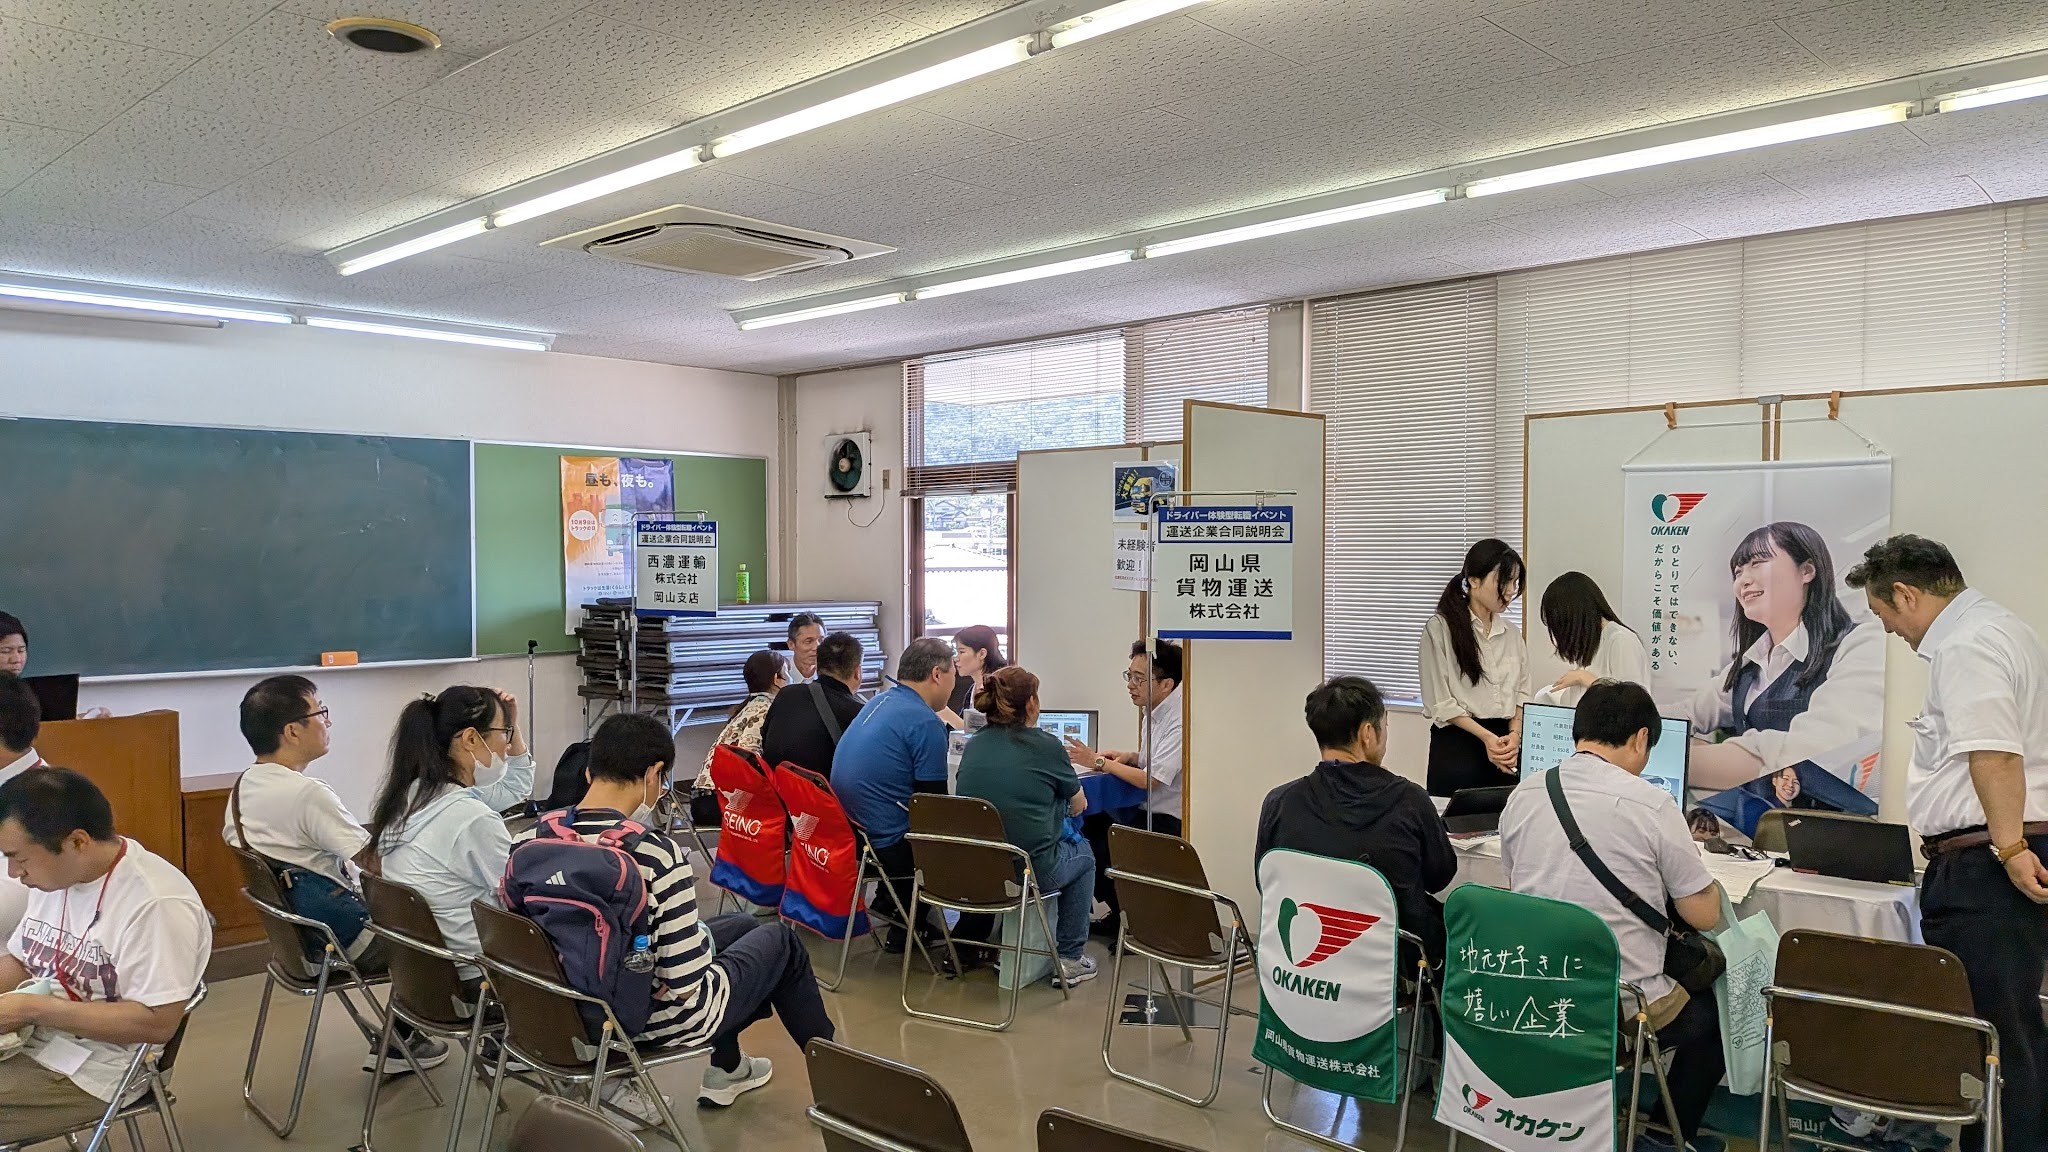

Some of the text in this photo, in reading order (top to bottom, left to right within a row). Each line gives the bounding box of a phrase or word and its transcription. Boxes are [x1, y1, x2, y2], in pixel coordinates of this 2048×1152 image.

[585, 473, 654, 488] 昼も、夜も。
[1166, 511, 1286, 520] ドライバー体験型転職イベント
[641, 534, 712, 544] 運送企業合同説明会
[1166, 525, 1285, 538] 運送企業合同説明会
[1651, 526, 1690, 536] OKAKEN
[648, 555, 706, 570] 西濃運輸
[1189, 553, 1260, 573] 岡山県
[655, 573, 698, 585] 株式会社
[1176, 578, 1273, 597] 貨物運送
[653, 591, 699, 604] 岡山支店
[1668, 543, 1681, 666] ひとりではできない、
[1189, 603, 1260, 619] 株式会社
[1651, 544, 1664, 670] だからこそ価値がある
[723, 811, 761, 836] SEINO
[1460, 937, 1583, 978] 地元好きに
[1272, 966, 1342, 1002] OKAKEN
[1464, 987, 1585, 1038] 嬉しい企業
[1265, 1028, 1380, 1078] 岡山県貨物運送株式会社
[1463, 1105, 1485, 1123] OKAKEN
[1494, 1107, 1585, 1142] オカケン
